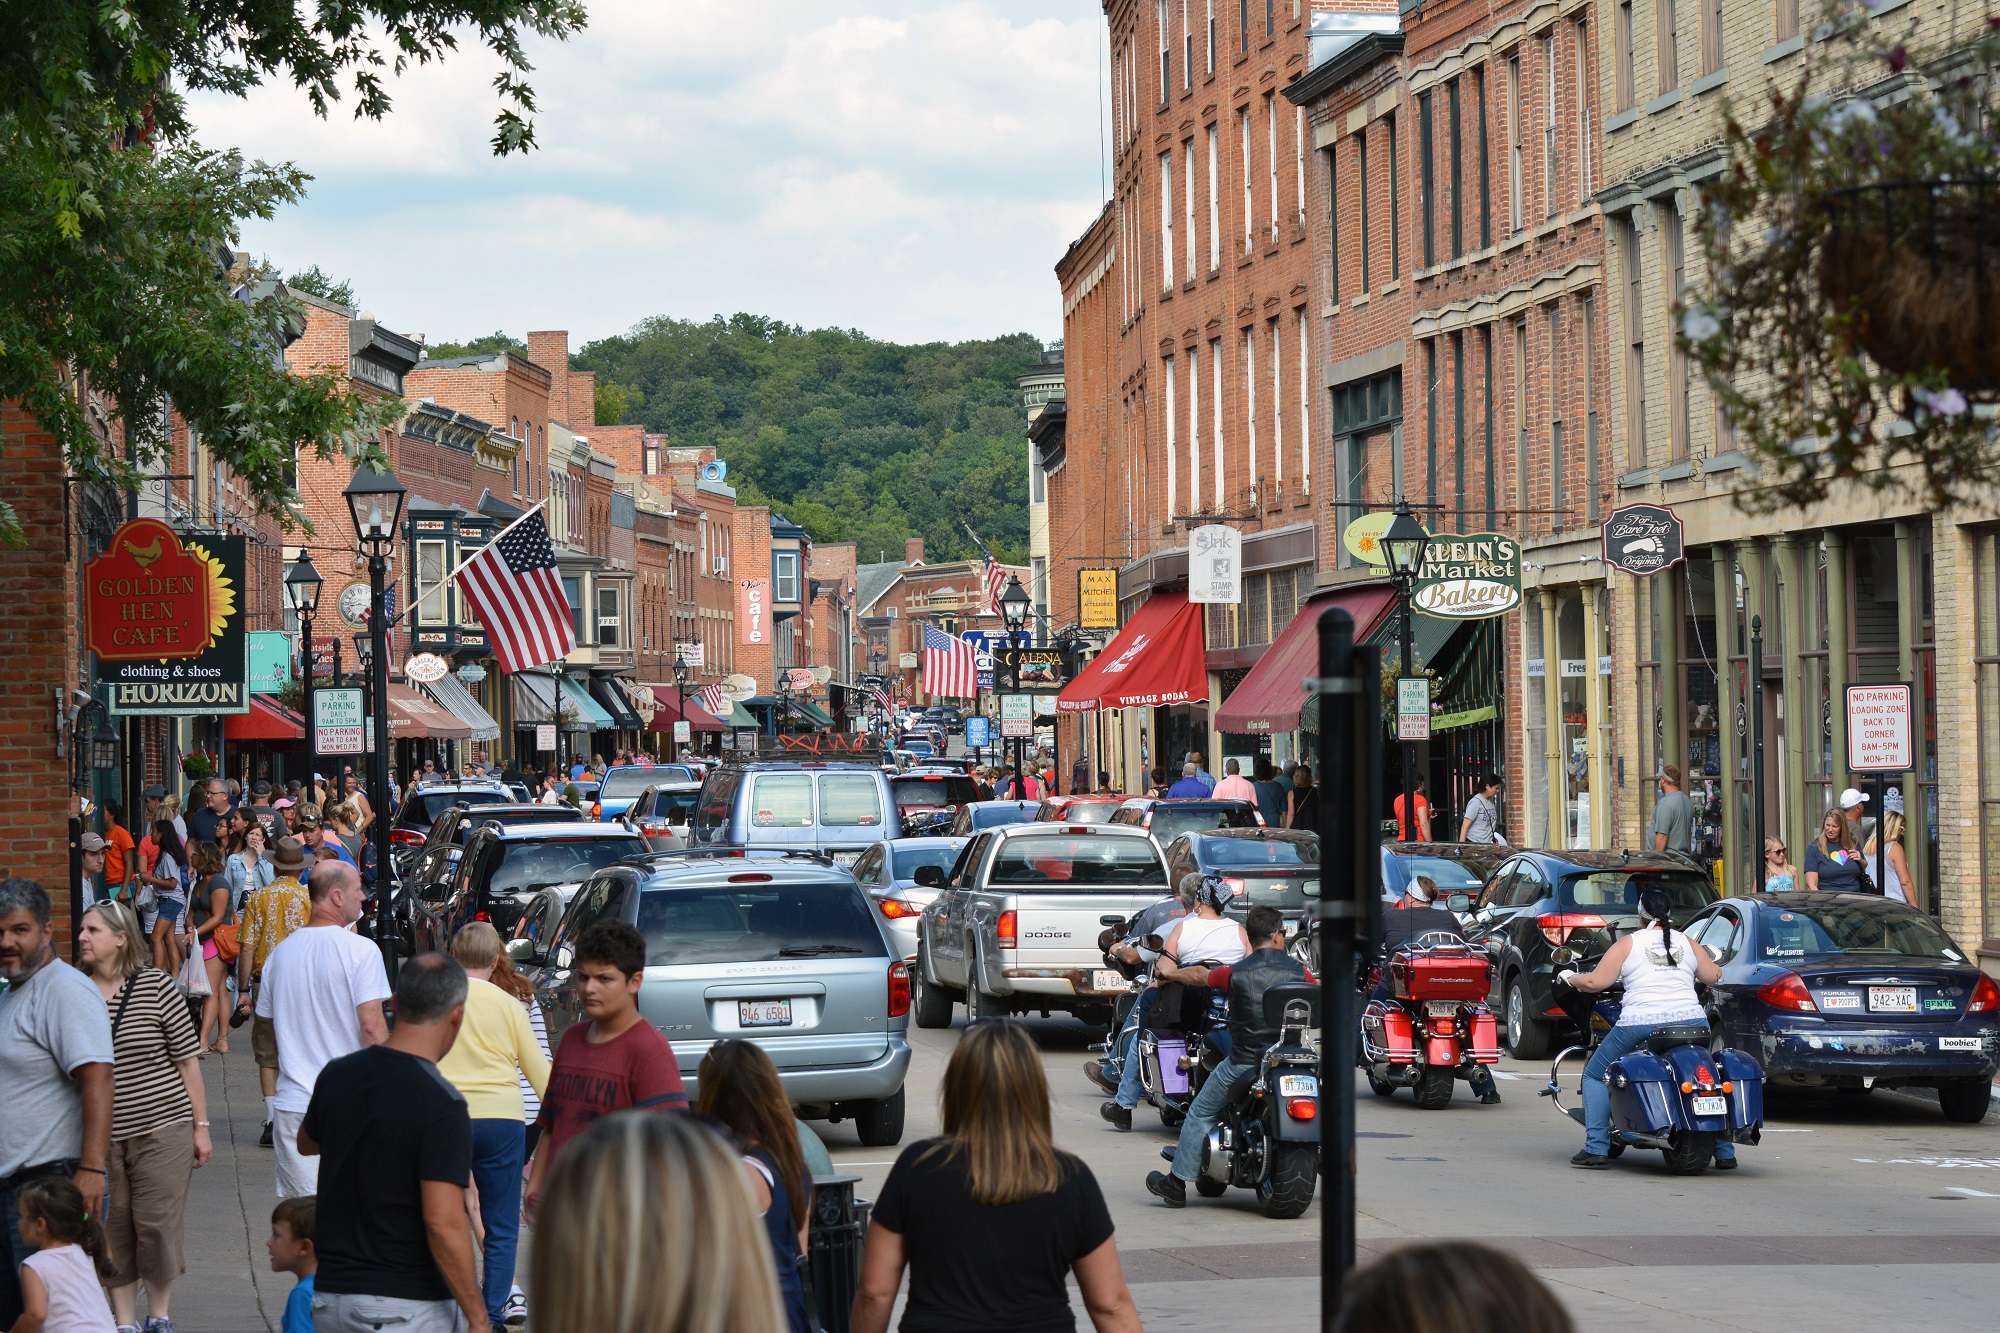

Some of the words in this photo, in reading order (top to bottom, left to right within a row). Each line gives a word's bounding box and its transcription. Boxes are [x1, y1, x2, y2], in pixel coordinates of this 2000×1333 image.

[1627, 515, 1650, 525] For
[1615, 524, 1643, 536] Bare
[1640, 523, 1669, 536] Feet
[1623, 555, 1663, 567] Originals
[1427, 562, 1515, 579] Market
[1087, 575, 1111, 583] MAX
[99, 575, 195, 597] GOLDEN
[1210, 581, 1232, 590] STAMP
[1082, 588, 1115, 596] MITCHELL
[1219, 591, 1232, 599] SUE
[1420, 579, 1515, 609] Bakery
[121, 601, 174, 621] HEN
[748, 589, 763, 644] cafe
[120, 665, 170, 680] clothing
[173, 665, 184, 677] &
[187, 665, 221, 677] shoes
[1407, 682, 1411, 690] 3
[1412, 682, 1421, 690] HR
[119, 682, 238, 704] HORIZON
[329, 692, 334, 701] 3
[337, 692, 347, 701] HR
[1119, 693, 1158, 705] VINTAGE
[1161, 690, 1190, 702] SODAS
[1402, 690, 1425, 699] PARKING
[1853, 692, 1865, 702] NO
[1866, 691, 1905, 701] PARKING
[321, 701, 356, 710] PARKING
[1852, 705, 1884, 715] LOADING
[1886, 704, 1906, 714] ZONE
[321, 717, 334, 725] 9AM
[1400, 714, 1407, 722] NO
[1407, 714, 1428, 722] PARKING
[1863, 717, 1883, 727] BACK
[1886, 717, 1895, 726] TO
[318, 728, 328, 736] NO
[329, 727, 361, 736] PARKING
[1864, 730, 1895, 739] CORNER
[1861, 742, 1899, 751] 8AM-5PM
[1863, 755, 1898, 763] MON-FRI
[1826, 998, 1830, 1007] I
[1873, 993, 1913, 1007] 942-XAC
[741, 1007, 760, 1022] 946
[766, 1006, 790, 1021] 6581
[1943, 1038, 1977, 1048] boobies!
